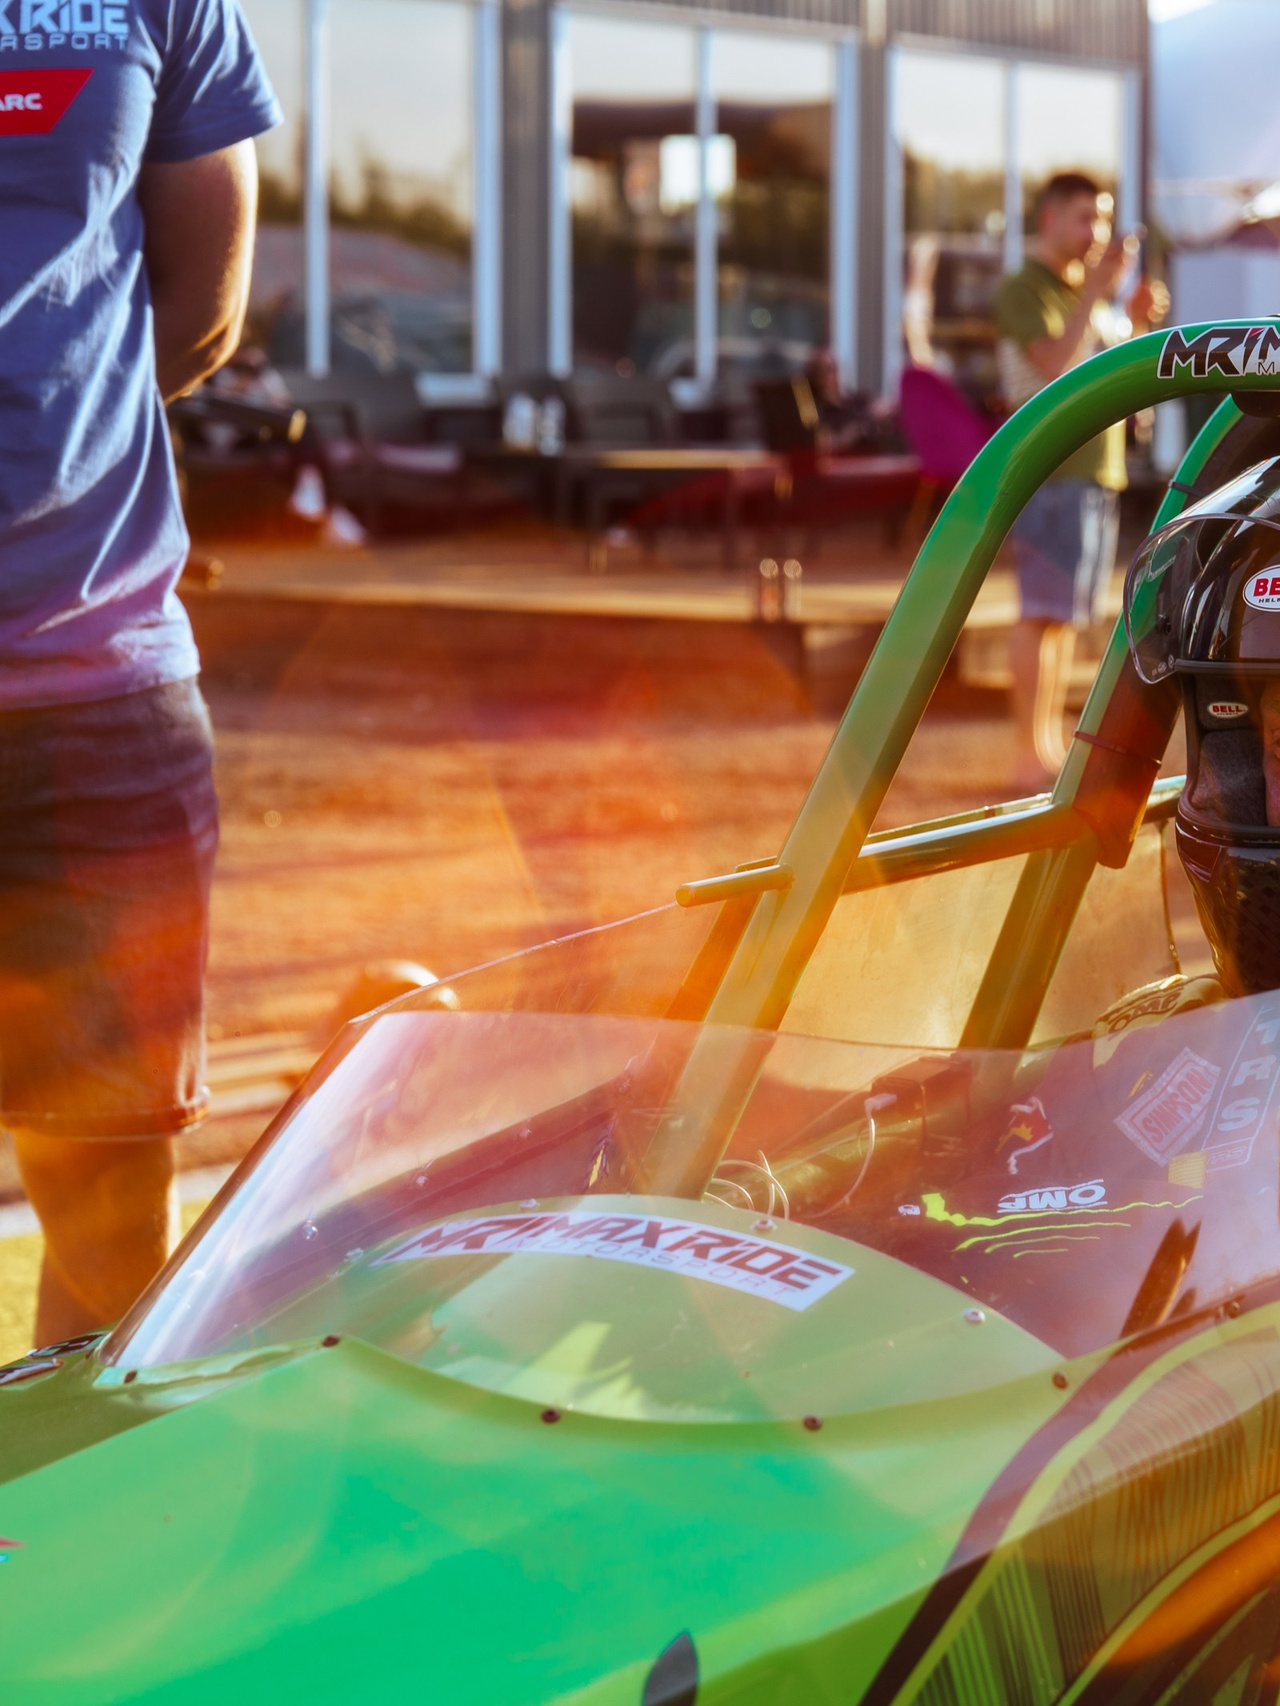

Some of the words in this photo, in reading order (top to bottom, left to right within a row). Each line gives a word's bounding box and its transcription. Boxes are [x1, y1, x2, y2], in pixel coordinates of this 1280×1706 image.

[1212, 704, 1243, 713] BELL
[1141, 1067, 1216, 1145] SIMPSON
[511, 1238, 798, 1297] MOTORSPORT
